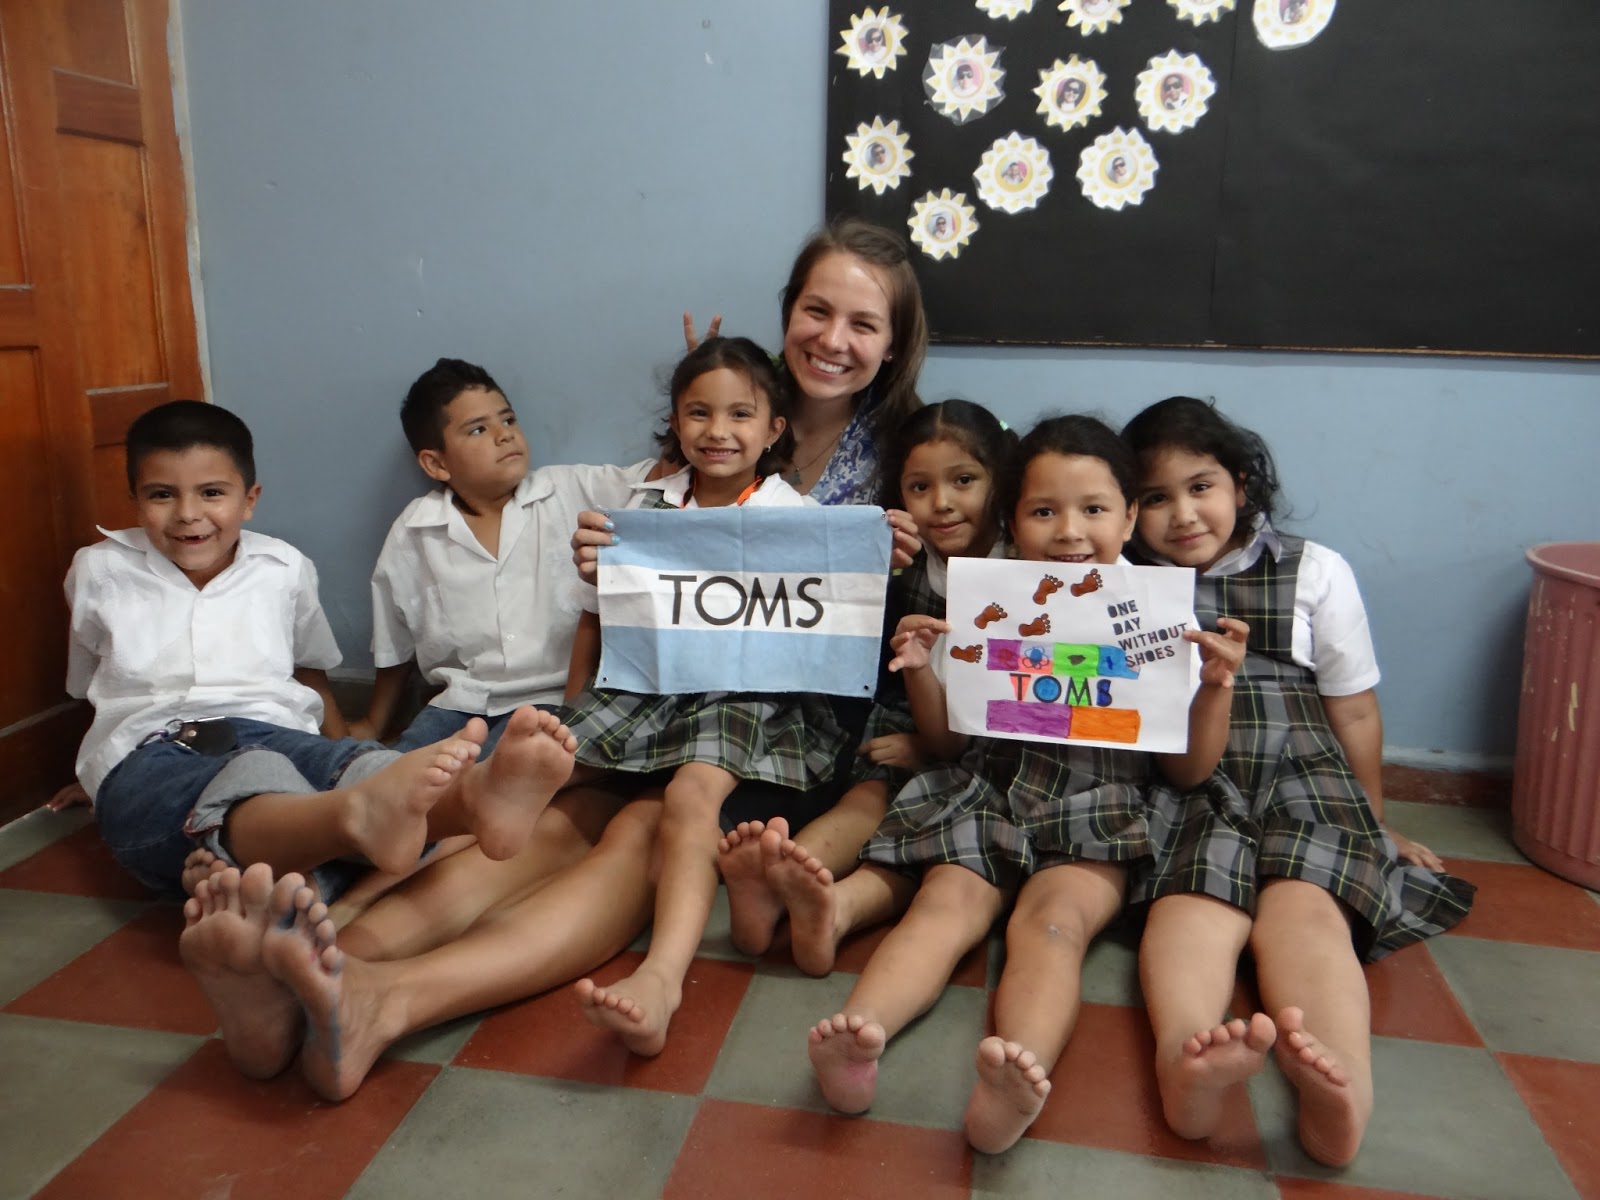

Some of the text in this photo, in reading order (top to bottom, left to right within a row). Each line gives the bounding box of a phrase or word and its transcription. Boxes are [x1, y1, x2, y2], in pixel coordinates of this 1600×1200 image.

[658, 574, 825, 629] TOMS
[1107, 600, 1139, 618] ONE
[1112, 616, 1141, 636] DAY
[1117, 622, 1188, 652] WITHOUT
[1124, 645, 1175, 668] SHOES
[1009, 672, 1113, 707] TOMS
